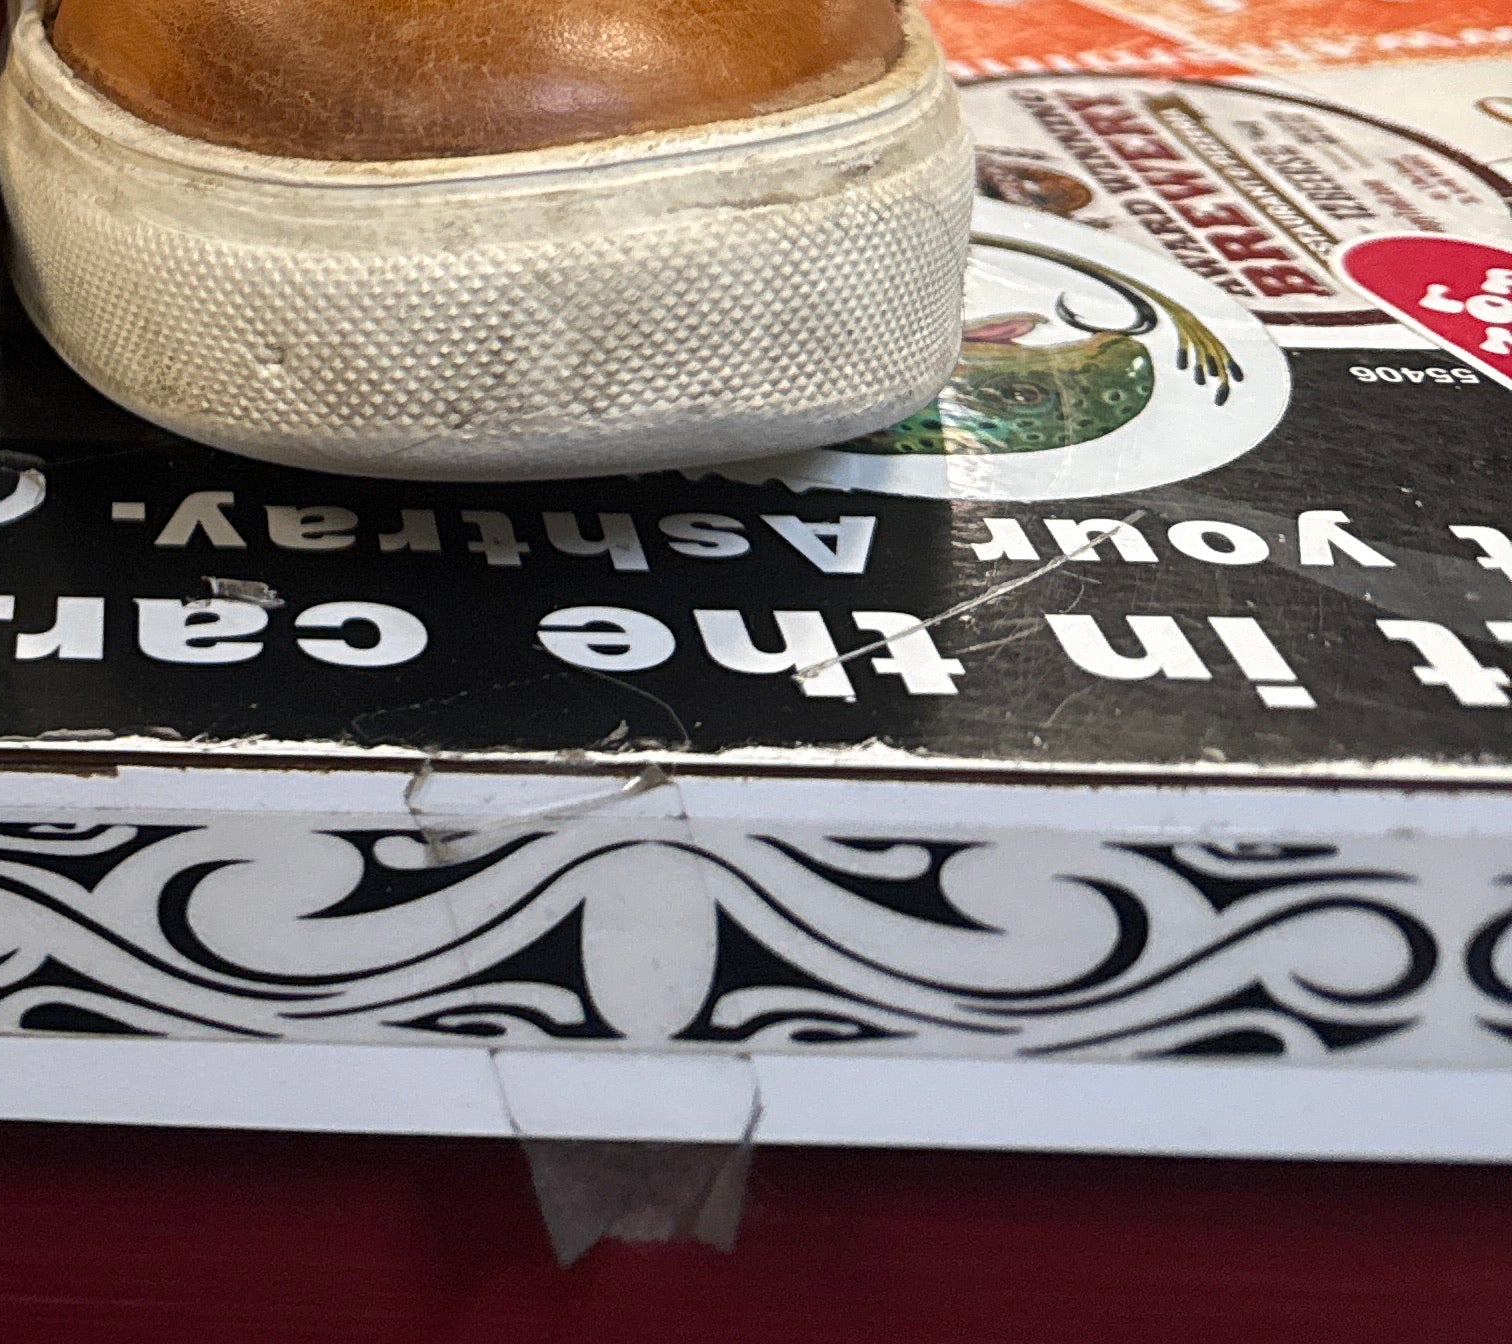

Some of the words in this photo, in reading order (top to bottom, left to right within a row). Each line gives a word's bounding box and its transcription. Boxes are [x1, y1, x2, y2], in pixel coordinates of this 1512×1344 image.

[1007, 88, 1139, 195] WINNING
[1054, 90, 1338, 298] BREWERY
[1242, 170, 1338, 259] STAURANT
[1120, 198, 1256, 297] AWARD
[1348, 366, 1480, 385] 55406
[111, 490, 877, 574] Ashtray.
[969, 509, 1397, 568] your
[537, 604, 965, 703] the
[1044, 613, 1318, 709] in
